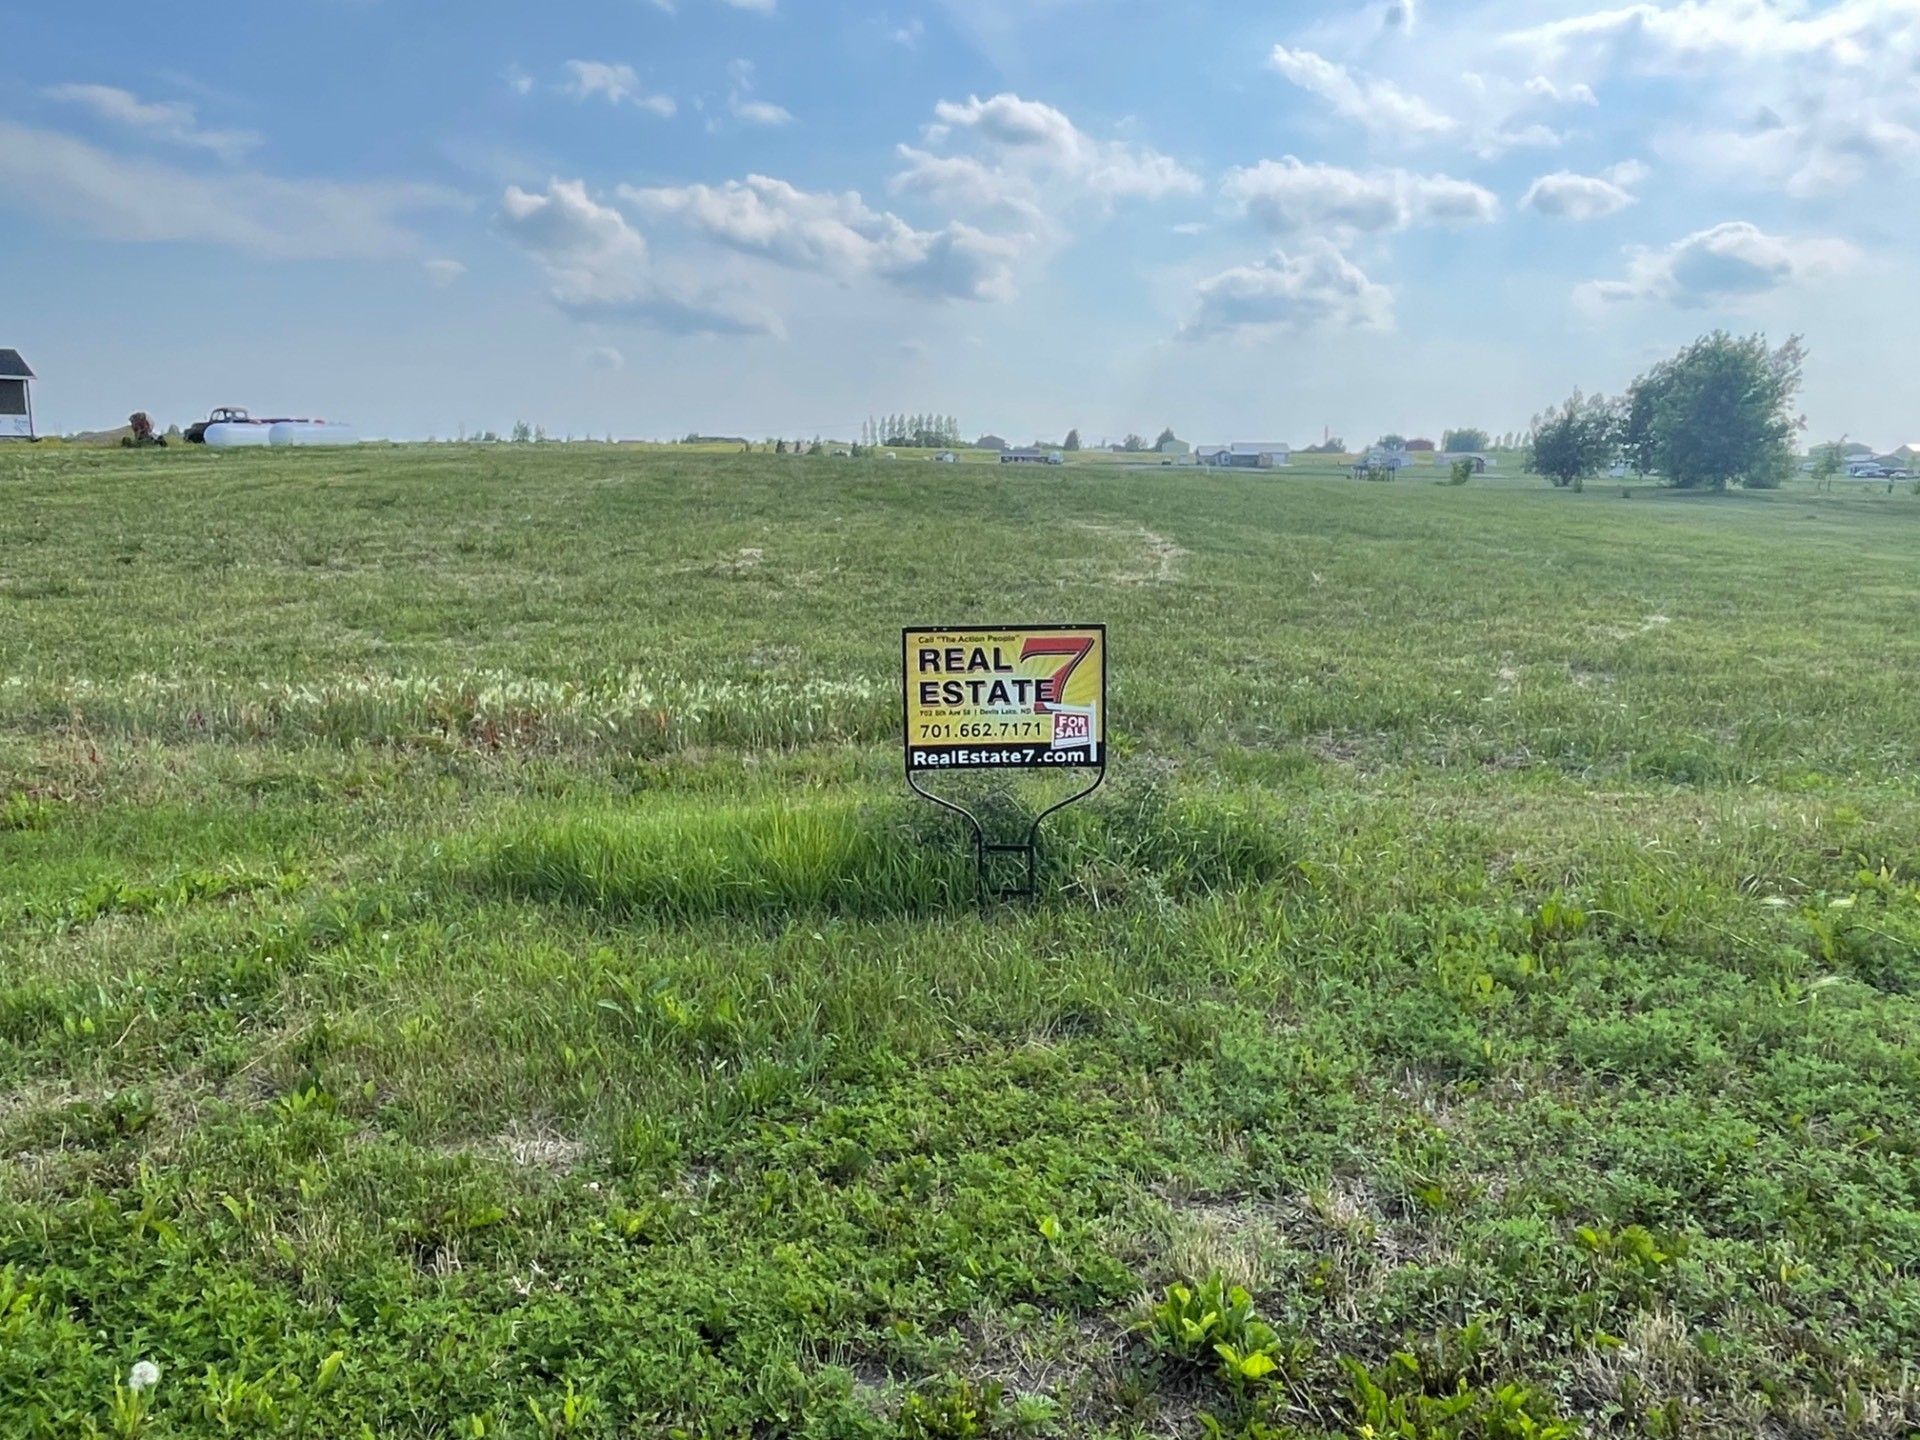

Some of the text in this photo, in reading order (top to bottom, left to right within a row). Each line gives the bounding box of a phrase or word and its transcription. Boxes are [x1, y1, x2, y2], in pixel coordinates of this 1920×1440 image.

[919, 646, 1014, 673] REAL
[1020, 636, 1095, 715] 7
[919, 679, 1056, 706] ESTATE
[920, 722, 1041, 738] 701.662.7171
[1059, 716, 1086, 728] FOR
[1055, 726, 1087, 738] SALE
[913, 749, 1085, 766] RealEstate7.com
